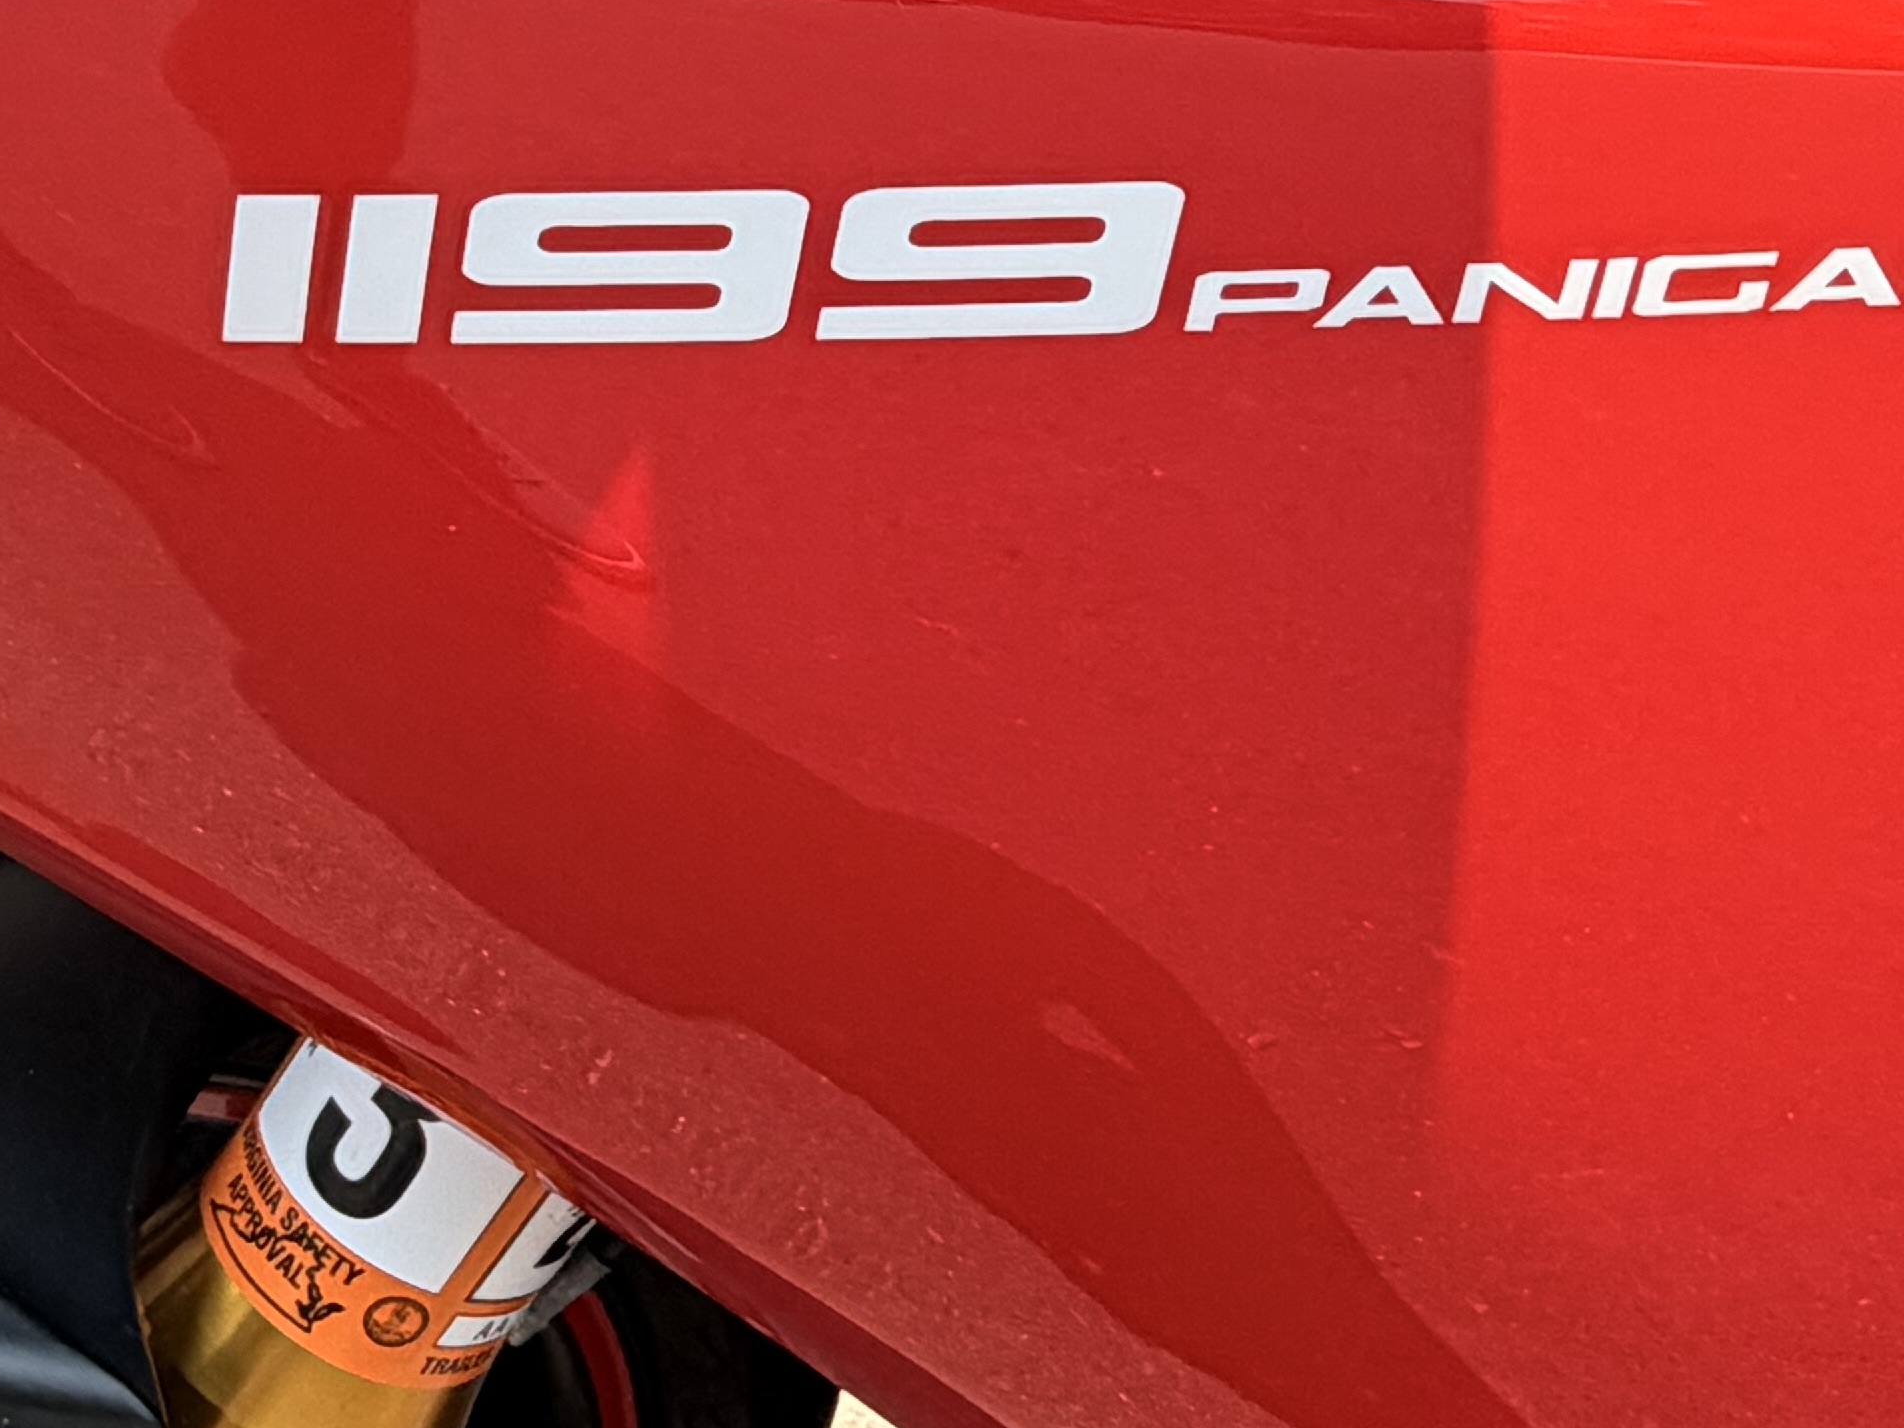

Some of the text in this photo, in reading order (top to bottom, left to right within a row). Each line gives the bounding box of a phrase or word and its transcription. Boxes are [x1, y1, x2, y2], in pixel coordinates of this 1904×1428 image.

[222, 180, 1185, 344] 1199
[227, 1172, 303, 1290] APPROVAL
[279, 1206, 366, 1286] SAFETY
